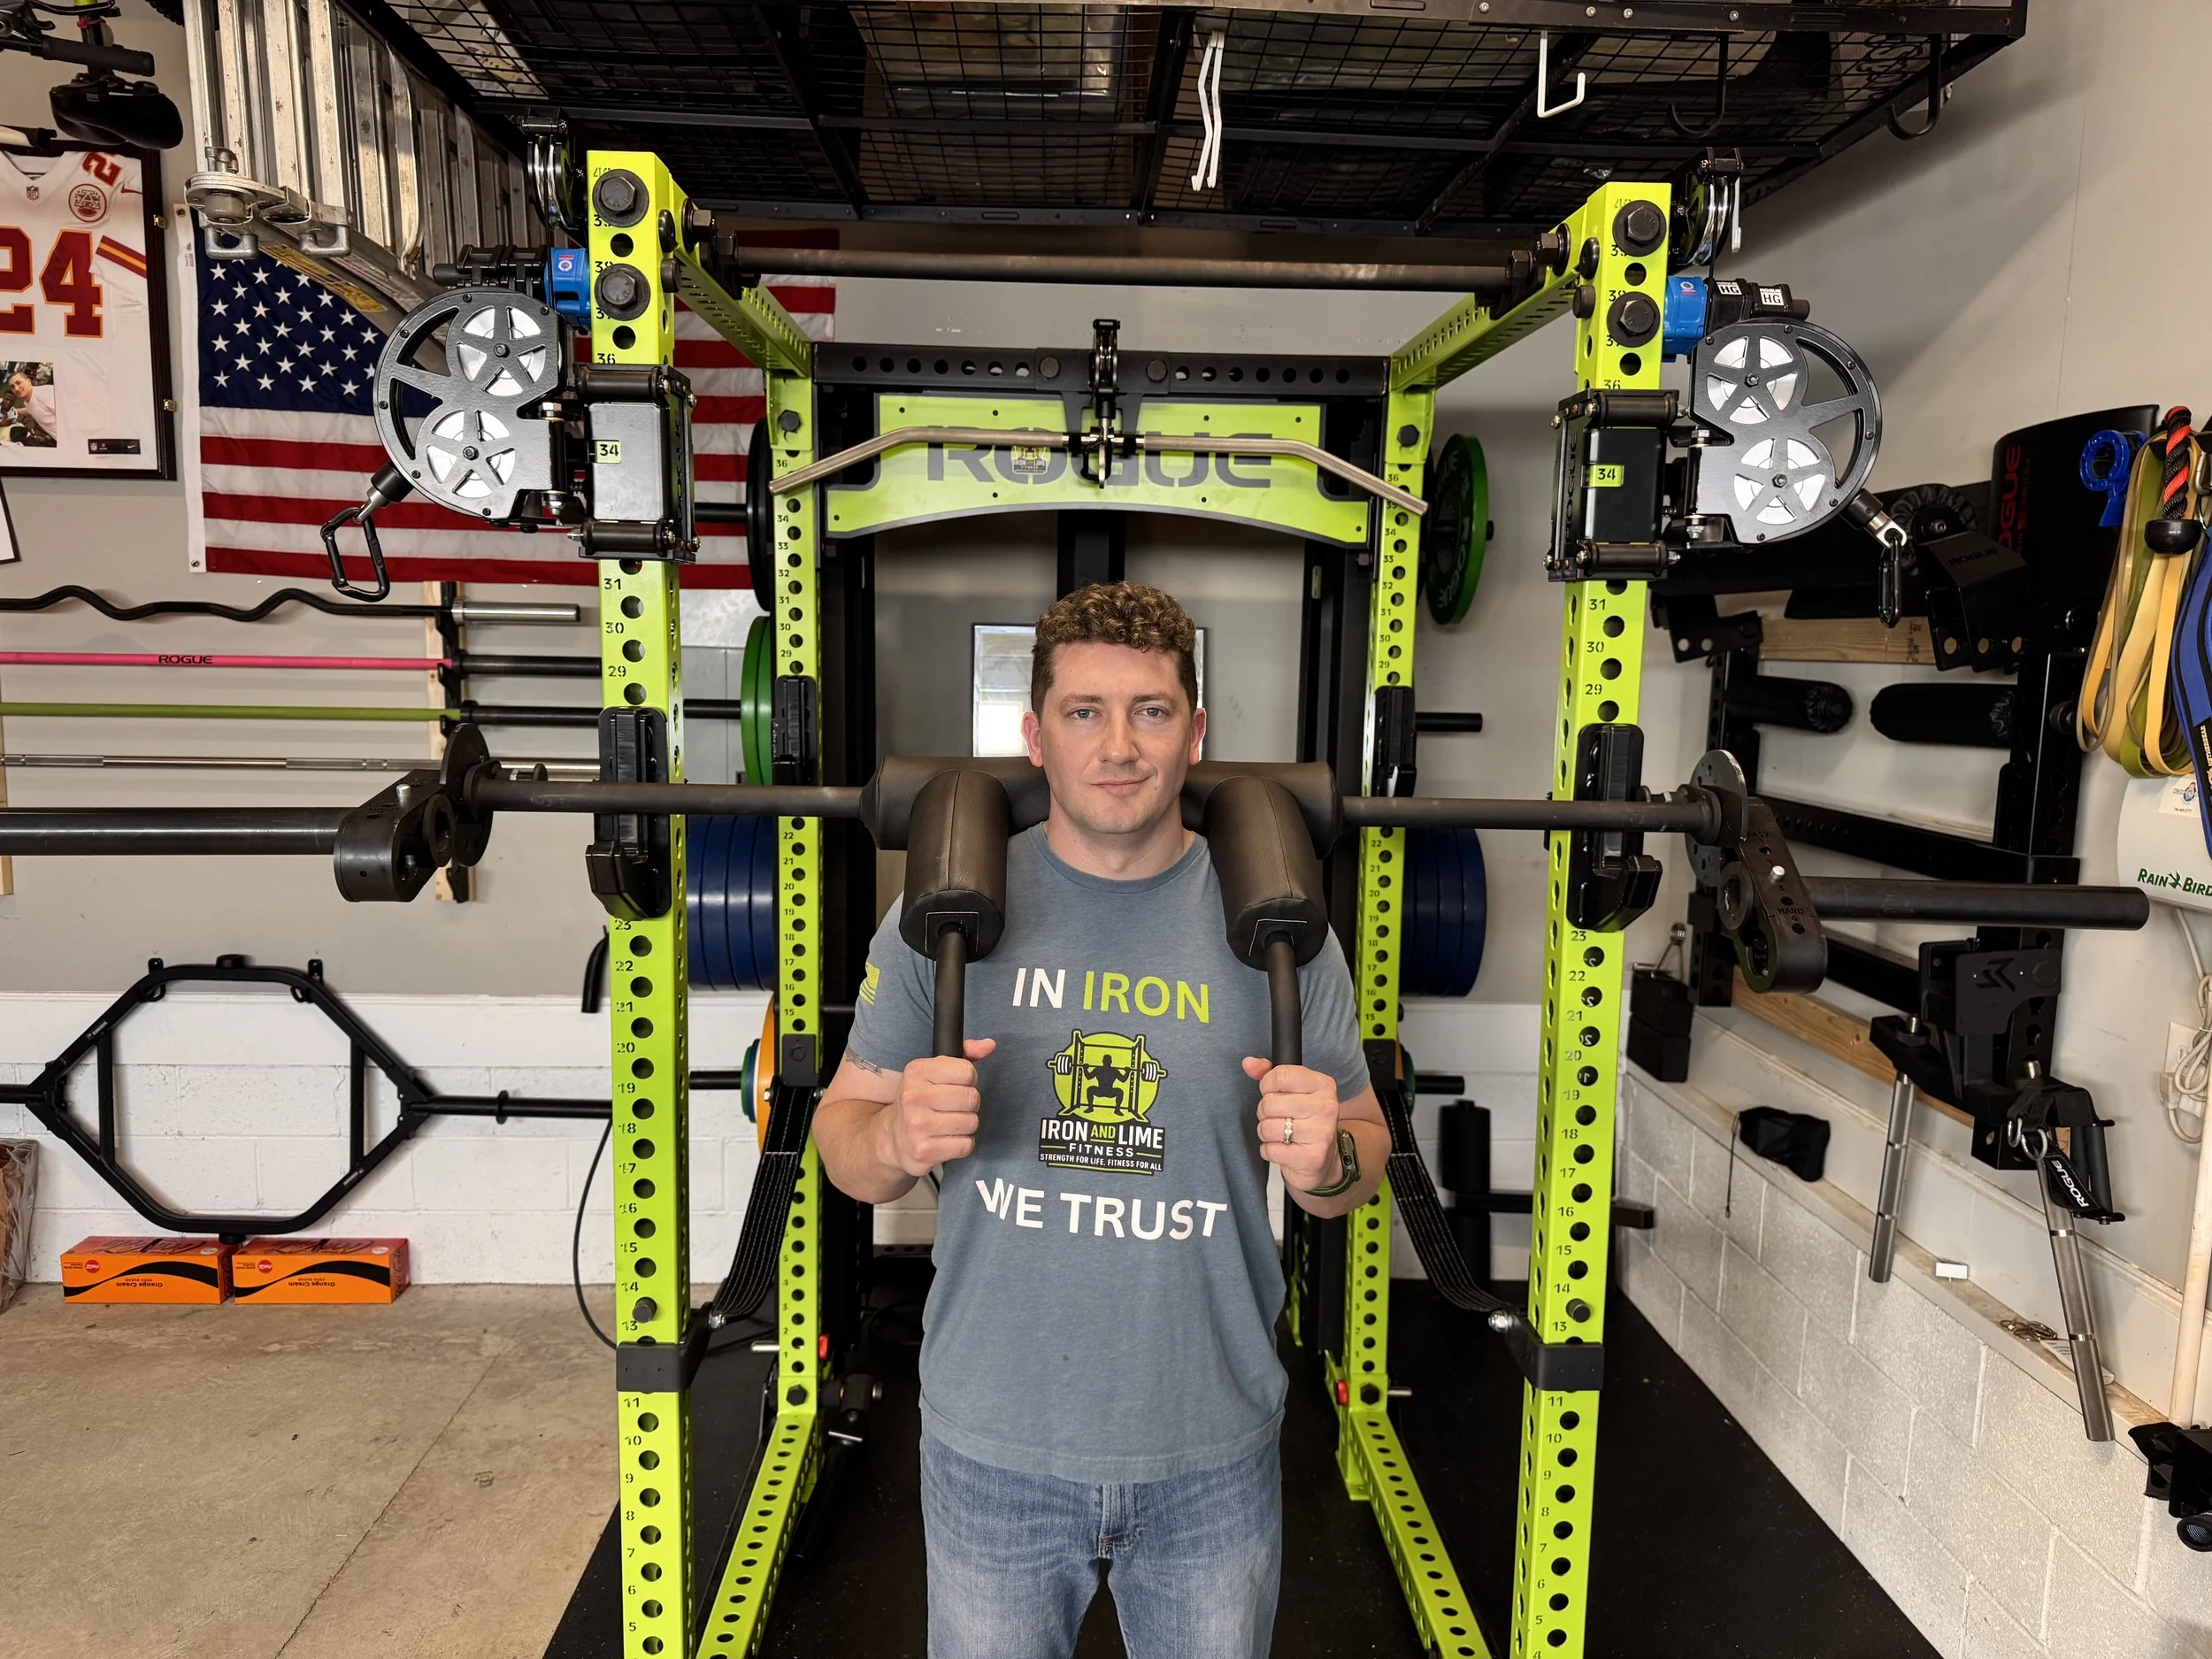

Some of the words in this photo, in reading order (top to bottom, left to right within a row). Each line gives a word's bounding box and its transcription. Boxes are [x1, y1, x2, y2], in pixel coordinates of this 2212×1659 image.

[1721, 286, 1740, 295] HG
[1763, 293, 1781, 303] HG
[596, 353, 616, 364] 36
[1603, 380, 1621, 389] 36
[599, 443, 619, 457] 34
[776, 460, 788, 468] 36
[1387, 474, 1399, 482] 36
[1597, 468, 1616, 480] 34
[1998, 446, 2021, 549] OGUE
[778, 542, 788, 550] 33
[603, 578, 621, 590] 31
[1589, 599, 1606, 611] 31
[606, 622, 625, 634] 30
[1586, 641, 1604, 653] 30
[158, 654, 213, 665] ROGUE
[608, 665, 626, 678] 29
[1585, 684, 1602, 695] 29
[2137, 868, 2169, 887] RAIN
[2182, 877, 2212, 897] BIRD
[615, 918, 632, 931] 23
[1571, 931, 1586, 941] 23
[616, 961, 634, 972] 22
[1568, 971, 1586, 982] 22
[1012, 968, 1065, 1009] IN
[1083, 971, 1210, 1024] IRON
[617, 1001, 634, 1013] 21
[1567, 1010, 1583, 1022] 21
[617, 1042, 635, 1053] 20
[1565, 1050, 1582, 1061] 20
[618, 1082, 636, 1094] 19
[1563, 1090, 1580, 1101] 19
[618, 1123, 636, 1134] 18
[1041, 1119, 1088, 1142] IRON
[1091, 1125, 1116, 1139] AND
[1118, 1125, 1164, 1149] LIME
[1561, 1129, 1578, 1140] 18
[1069, 1143, 1134, 1158] FITNESS
[1040, 1153, 1075, 1163] STRENGTH
[1076, 1156, 1089, 1164] FOR
[1090, 1157, 1106, 1166] LIFE.
[1108, 1159, 1134, 1168] FITNESS
[1136, 1160, 1149, 1169] FOR
[1150, 1162, 1162, 1171] ALL
[619, 1163, 636, 1174] 17
[1559, 1168, 1576, 1179] 17
[2051, 1160, 2090, 1208] ROGUE
[619, 1202, 638, 1214] 16
[975, 1177, 1045, 1229] WE
[1060, 1192, 1228, 1240] TRUST
[1558, 1206, 1575, 1217] 16
[620, 1242, 638, 1253] 15
[1555, 1245, 1572, 1256] 15
[621, 1281, 639, 1293] 14
[1554, 1283, 1571, 1294] 14
[622, 1319, 638, 1331] 13
[1552, 1321, 1567, 1332] 13
[624, 1397, 640, 1409] 11
[1548, 1396, 1563, 1407] 11
[625, 1435, 641, 1446] 10
[1546, 1433, 1563, 1444] 10
[626, 1473, 634, 1484] 9
[1544, 1470, 1552, 1480] 9
[626, 1510, 634, 1521] 8
[1541, 1507, 1550, 1517] 8
[627, 1548, 635, 1558] 7
[1540, 1543, 1548, 1553] 7
[628, 1585, 636, 1595] 6
[1537, 1579, 1545, 1590] 6
[1536, 1615, 1544, 1625] 5
[629, 1622, 637, 1632] 5
[1533, 1650, 1542, 1659] 4
